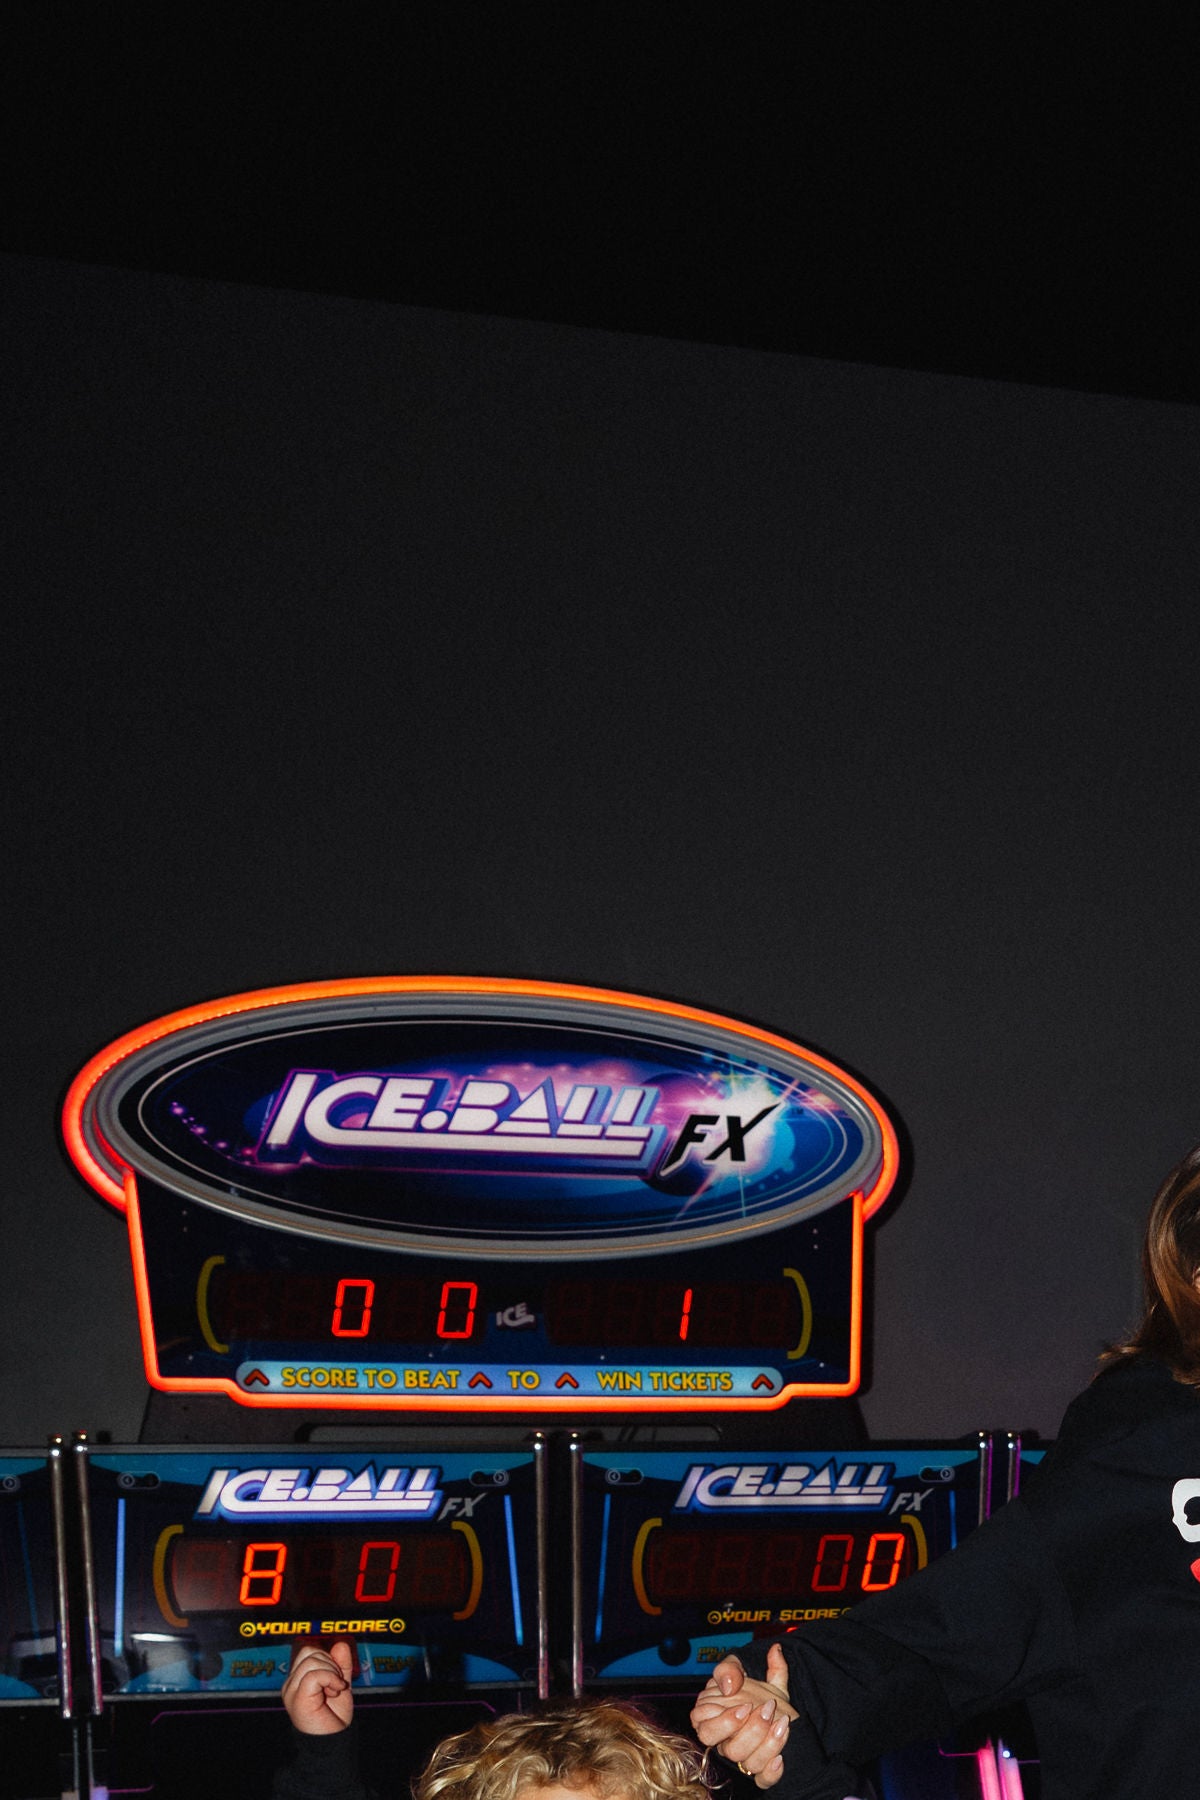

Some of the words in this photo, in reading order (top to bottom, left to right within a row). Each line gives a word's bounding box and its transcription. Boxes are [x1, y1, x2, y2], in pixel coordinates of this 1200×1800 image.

[657, 1102, 783, 1178] FX
[331, 1279, 375, 1338] 0
[437, 1281, 478, 1338] 0
[495, 1302, 536, 1328] ICE
[679, 1289, 693, 1340] 1
[281, 1367, 358, 1388] SCORE
[365, 1367, 398, 1388] TO
[403, 1368, 461, 1389] BEAT
[508, 1369, 540, 1389] TO
[597, 1370, 643, 1390] WIN
[649, 1371, 733, 1391] TICKETS
[437, 1492, 487, 1522] FX
[888, 1488, 935, 1516] FX
[240, 1543, 288, 1606] 8
[355, 1541, 401, 1603] 0
[256, 1621, 312, 1635] YOUR
[320, 1619, 390, 1634] SCORE
[723, 1609, 770, 1623] YOUR
[778, 1608, 840, 1622] SCORE
